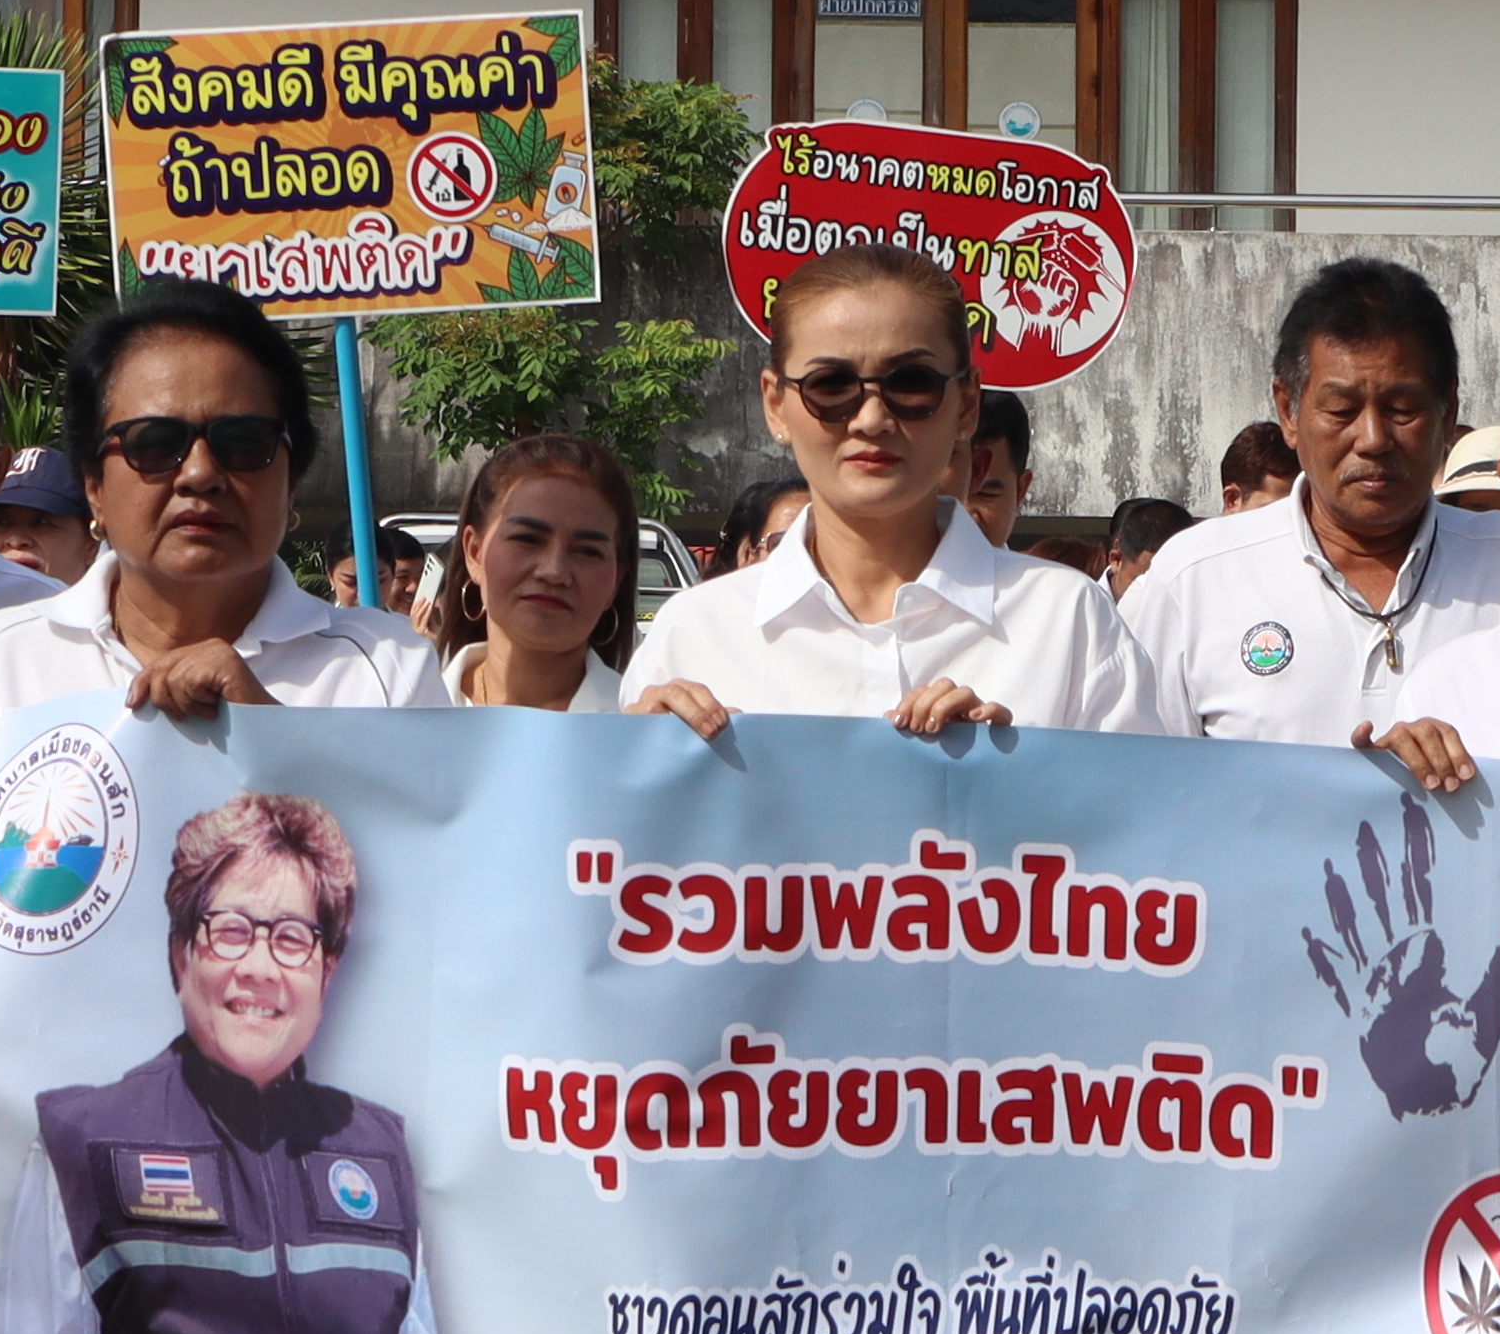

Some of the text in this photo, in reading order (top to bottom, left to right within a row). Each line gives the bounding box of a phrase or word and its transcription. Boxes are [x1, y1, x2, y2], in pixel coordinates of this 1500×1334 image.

[130, 34, 546, 122] สังคมดี มีคุณค่า
[169, 138, 383, 203] ถ้าปลอด
[776, 134, 1102, 211] ไร้อนาคตหมดโอกาส
